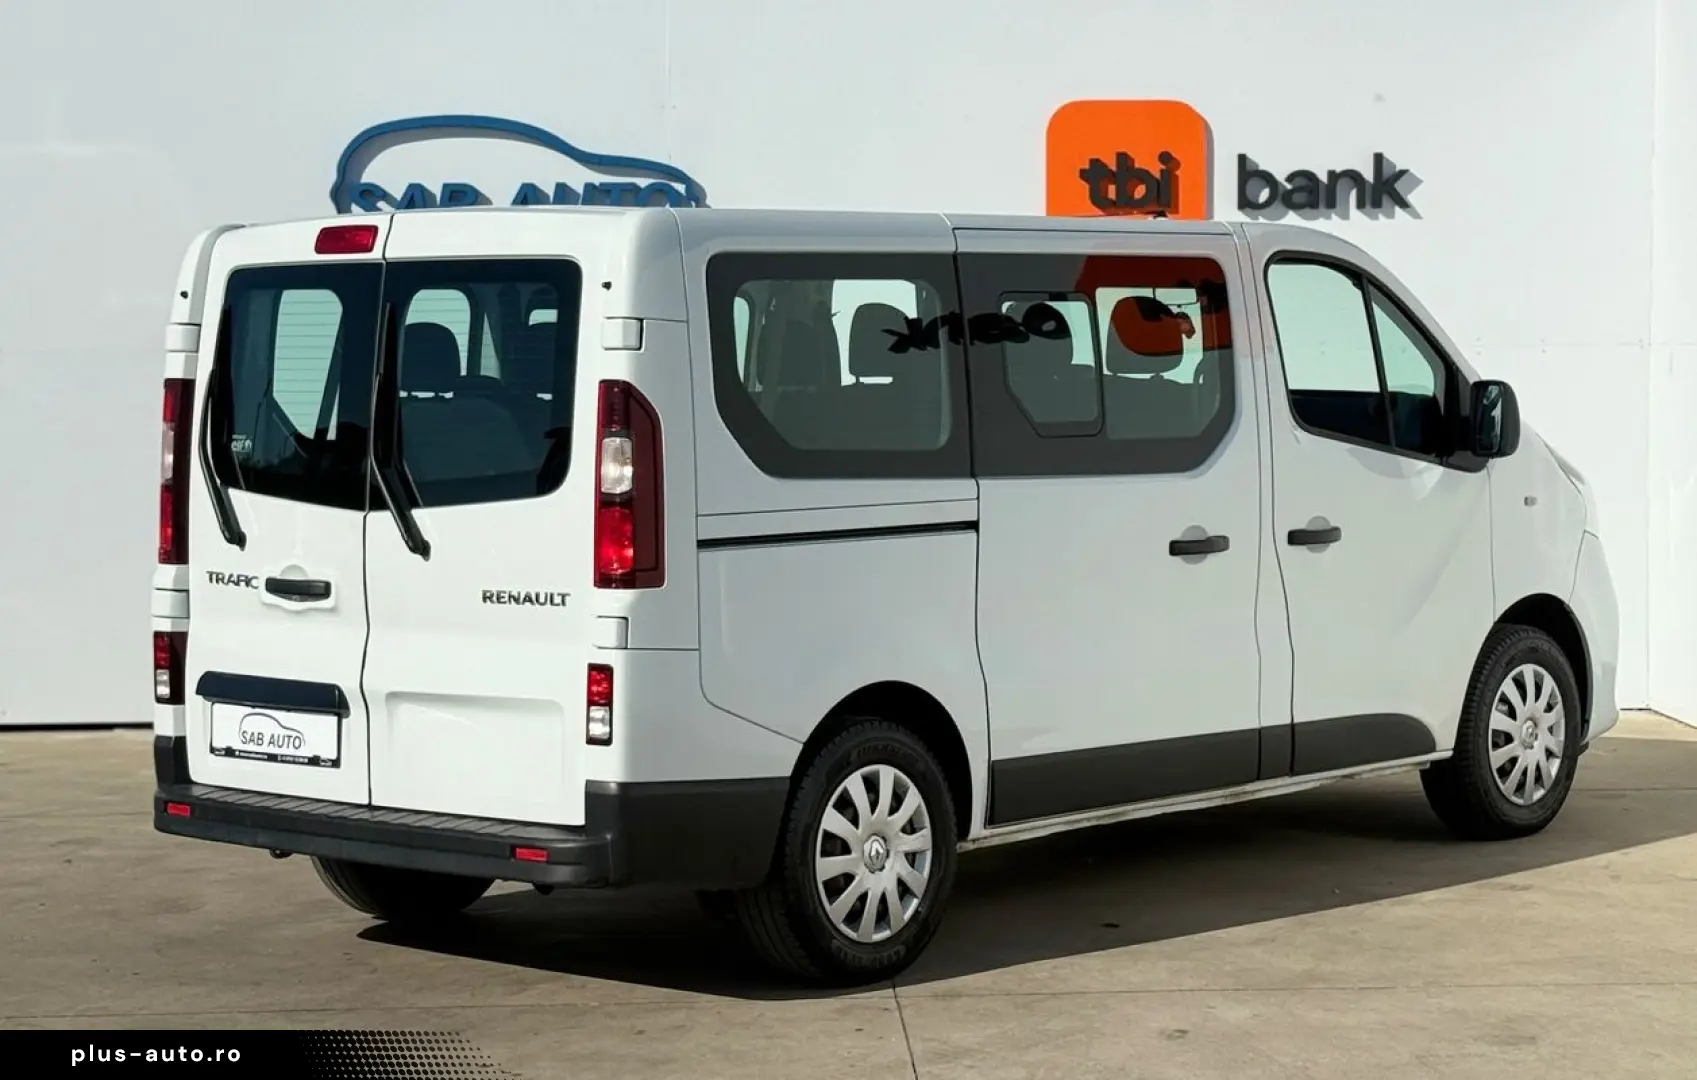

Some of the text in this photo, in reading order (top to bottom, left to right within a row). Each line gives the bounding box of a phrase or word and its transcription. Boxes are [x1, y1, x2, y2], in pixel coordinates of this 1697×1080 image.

[1079, 151, 1412, 212] tbi bank
[481, 589, 571, 607] RENAULT
[241, 730, 302, 750] SAB AUTO
